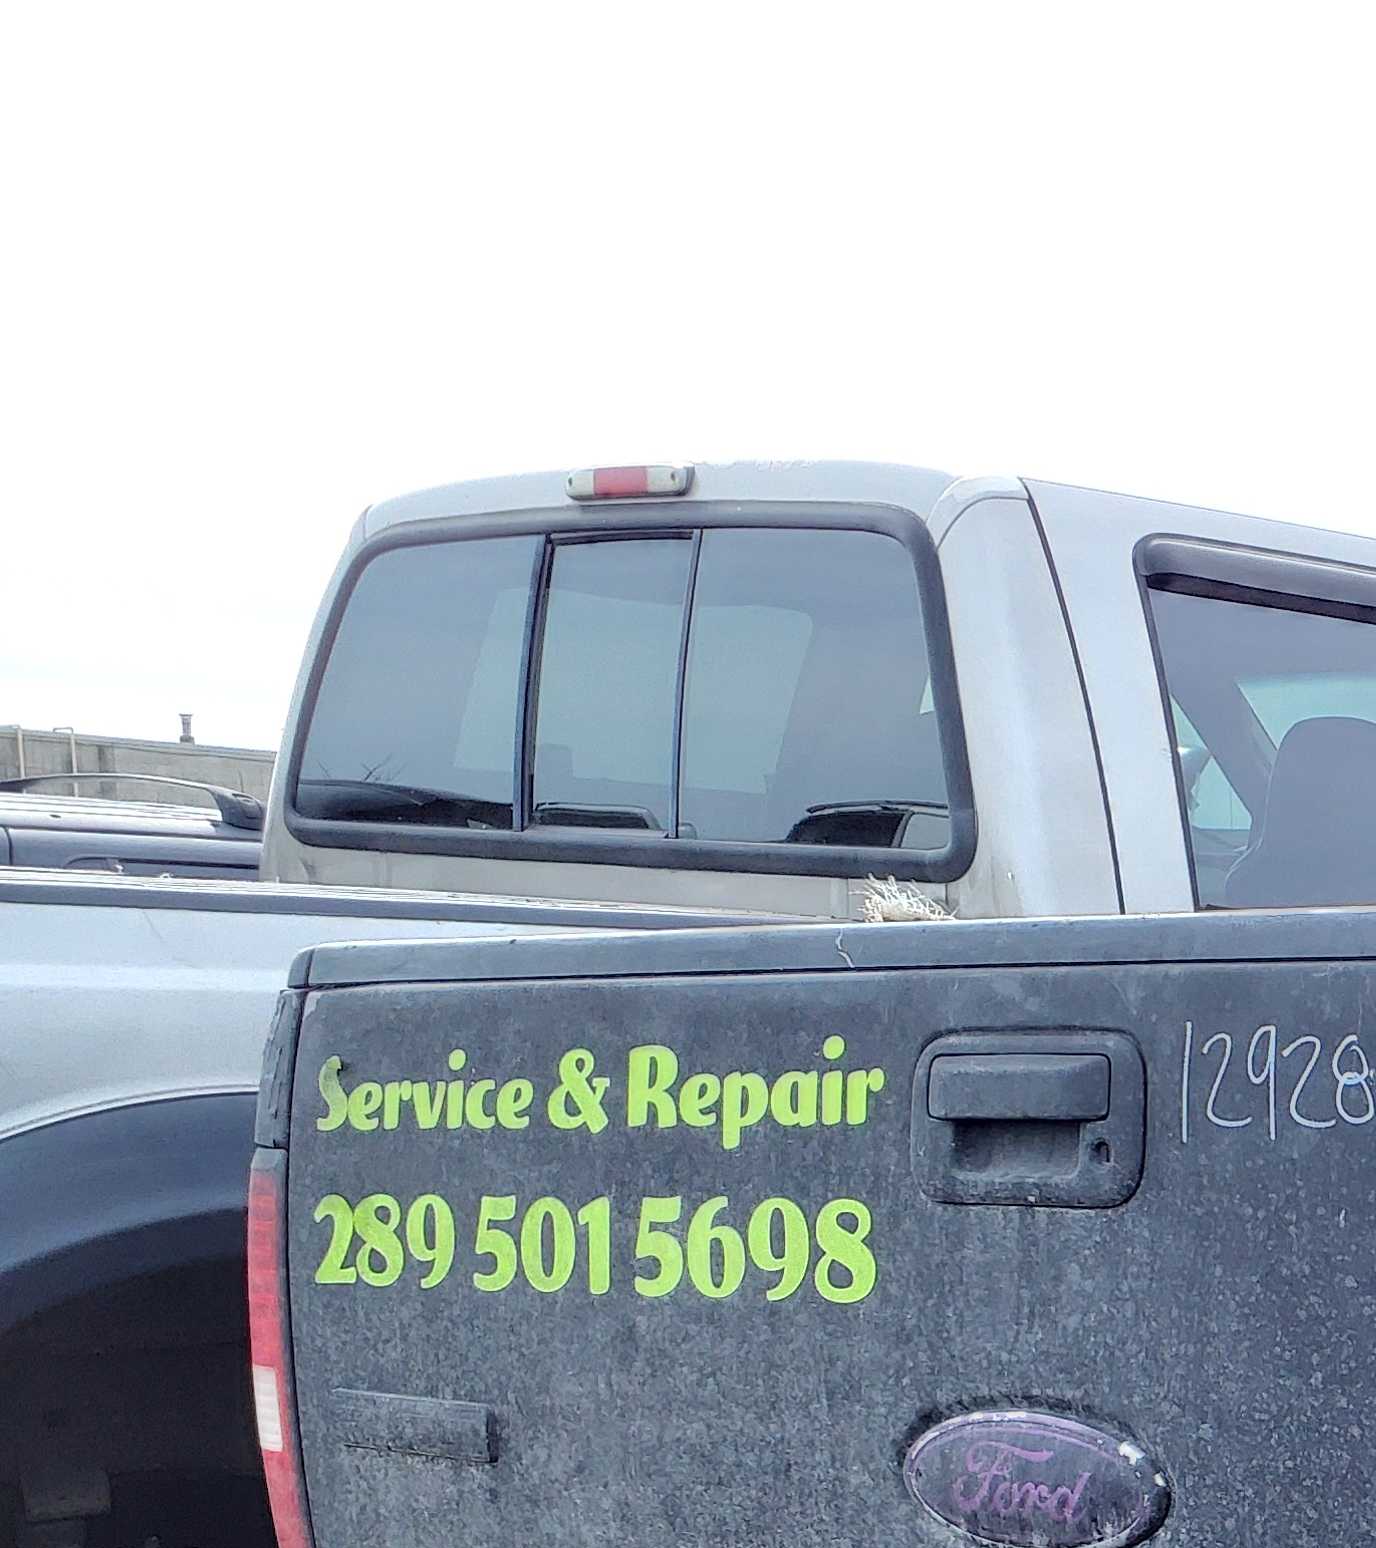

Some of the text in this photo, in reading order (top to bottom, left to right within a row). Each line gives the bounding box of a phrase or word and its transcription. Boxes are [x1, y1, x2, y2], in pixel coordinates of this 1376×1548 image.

[316, 1034, 885, 1150] Service & Repair
[313, 1193, 877, 1304] 289 501 5698
[952, 1439, 1092, 1522] Ford
